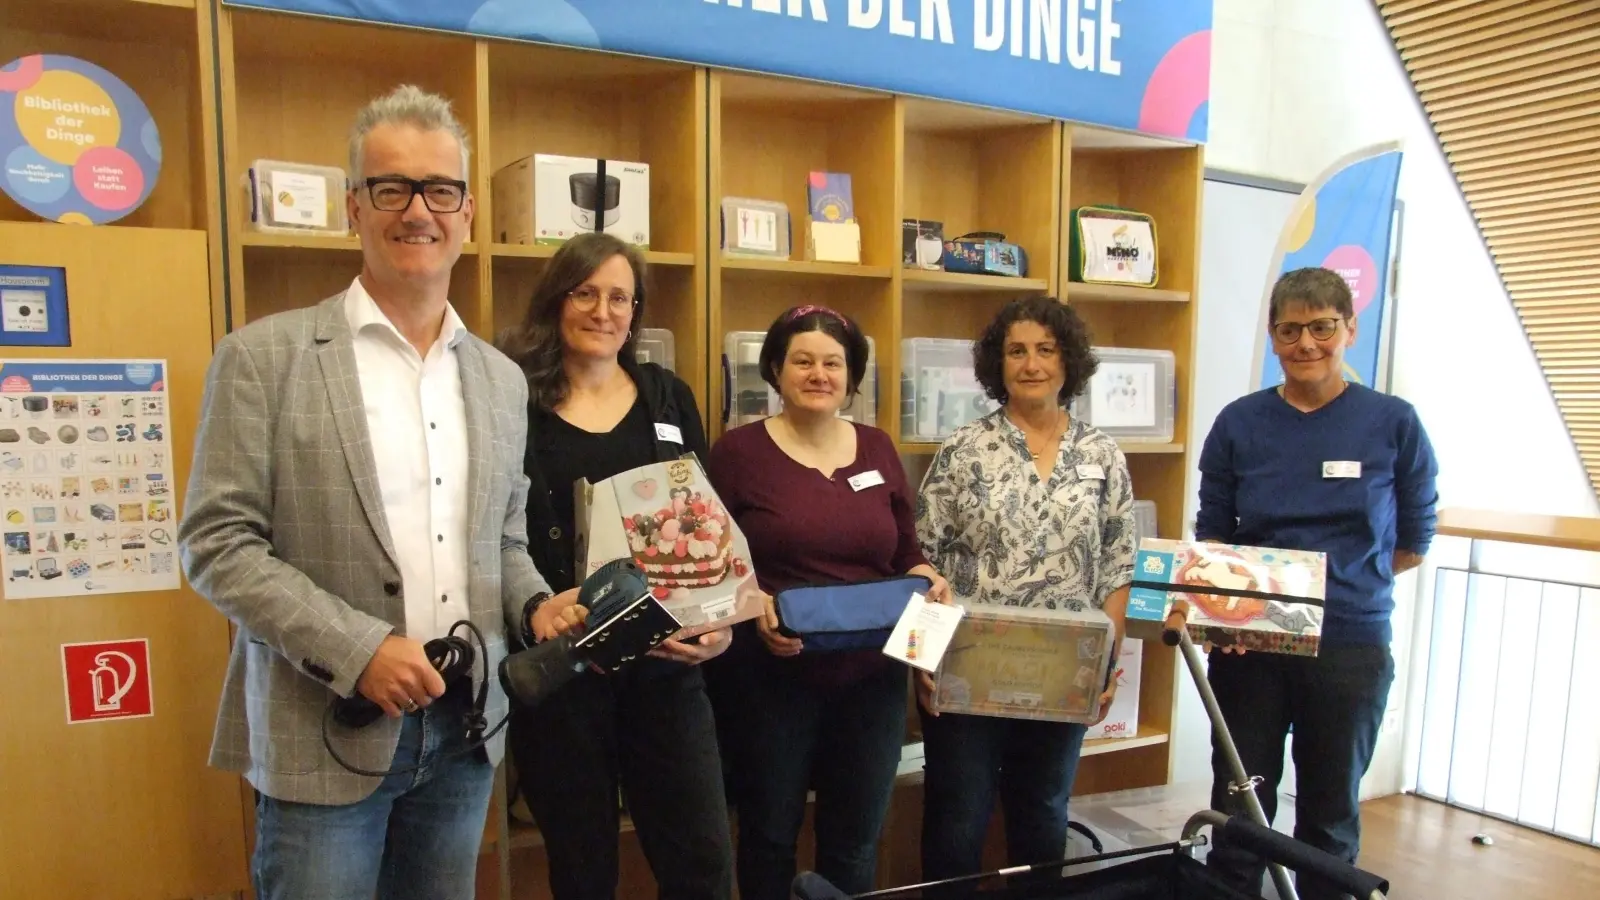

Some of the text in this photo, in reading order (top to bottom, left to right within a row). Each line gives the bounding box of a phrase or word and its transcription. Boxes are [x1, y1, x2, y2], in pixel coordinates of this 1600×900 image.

[974, 0, 1121, 76] DINGE
[24, 96, 111, 116] Bibliothek
[56, 115, 83, 127] der
[47, 128, 95, 145] Dinge
[92, 165, 124, 175] Leihen
[94, 181, 127, 191] Kaufen
